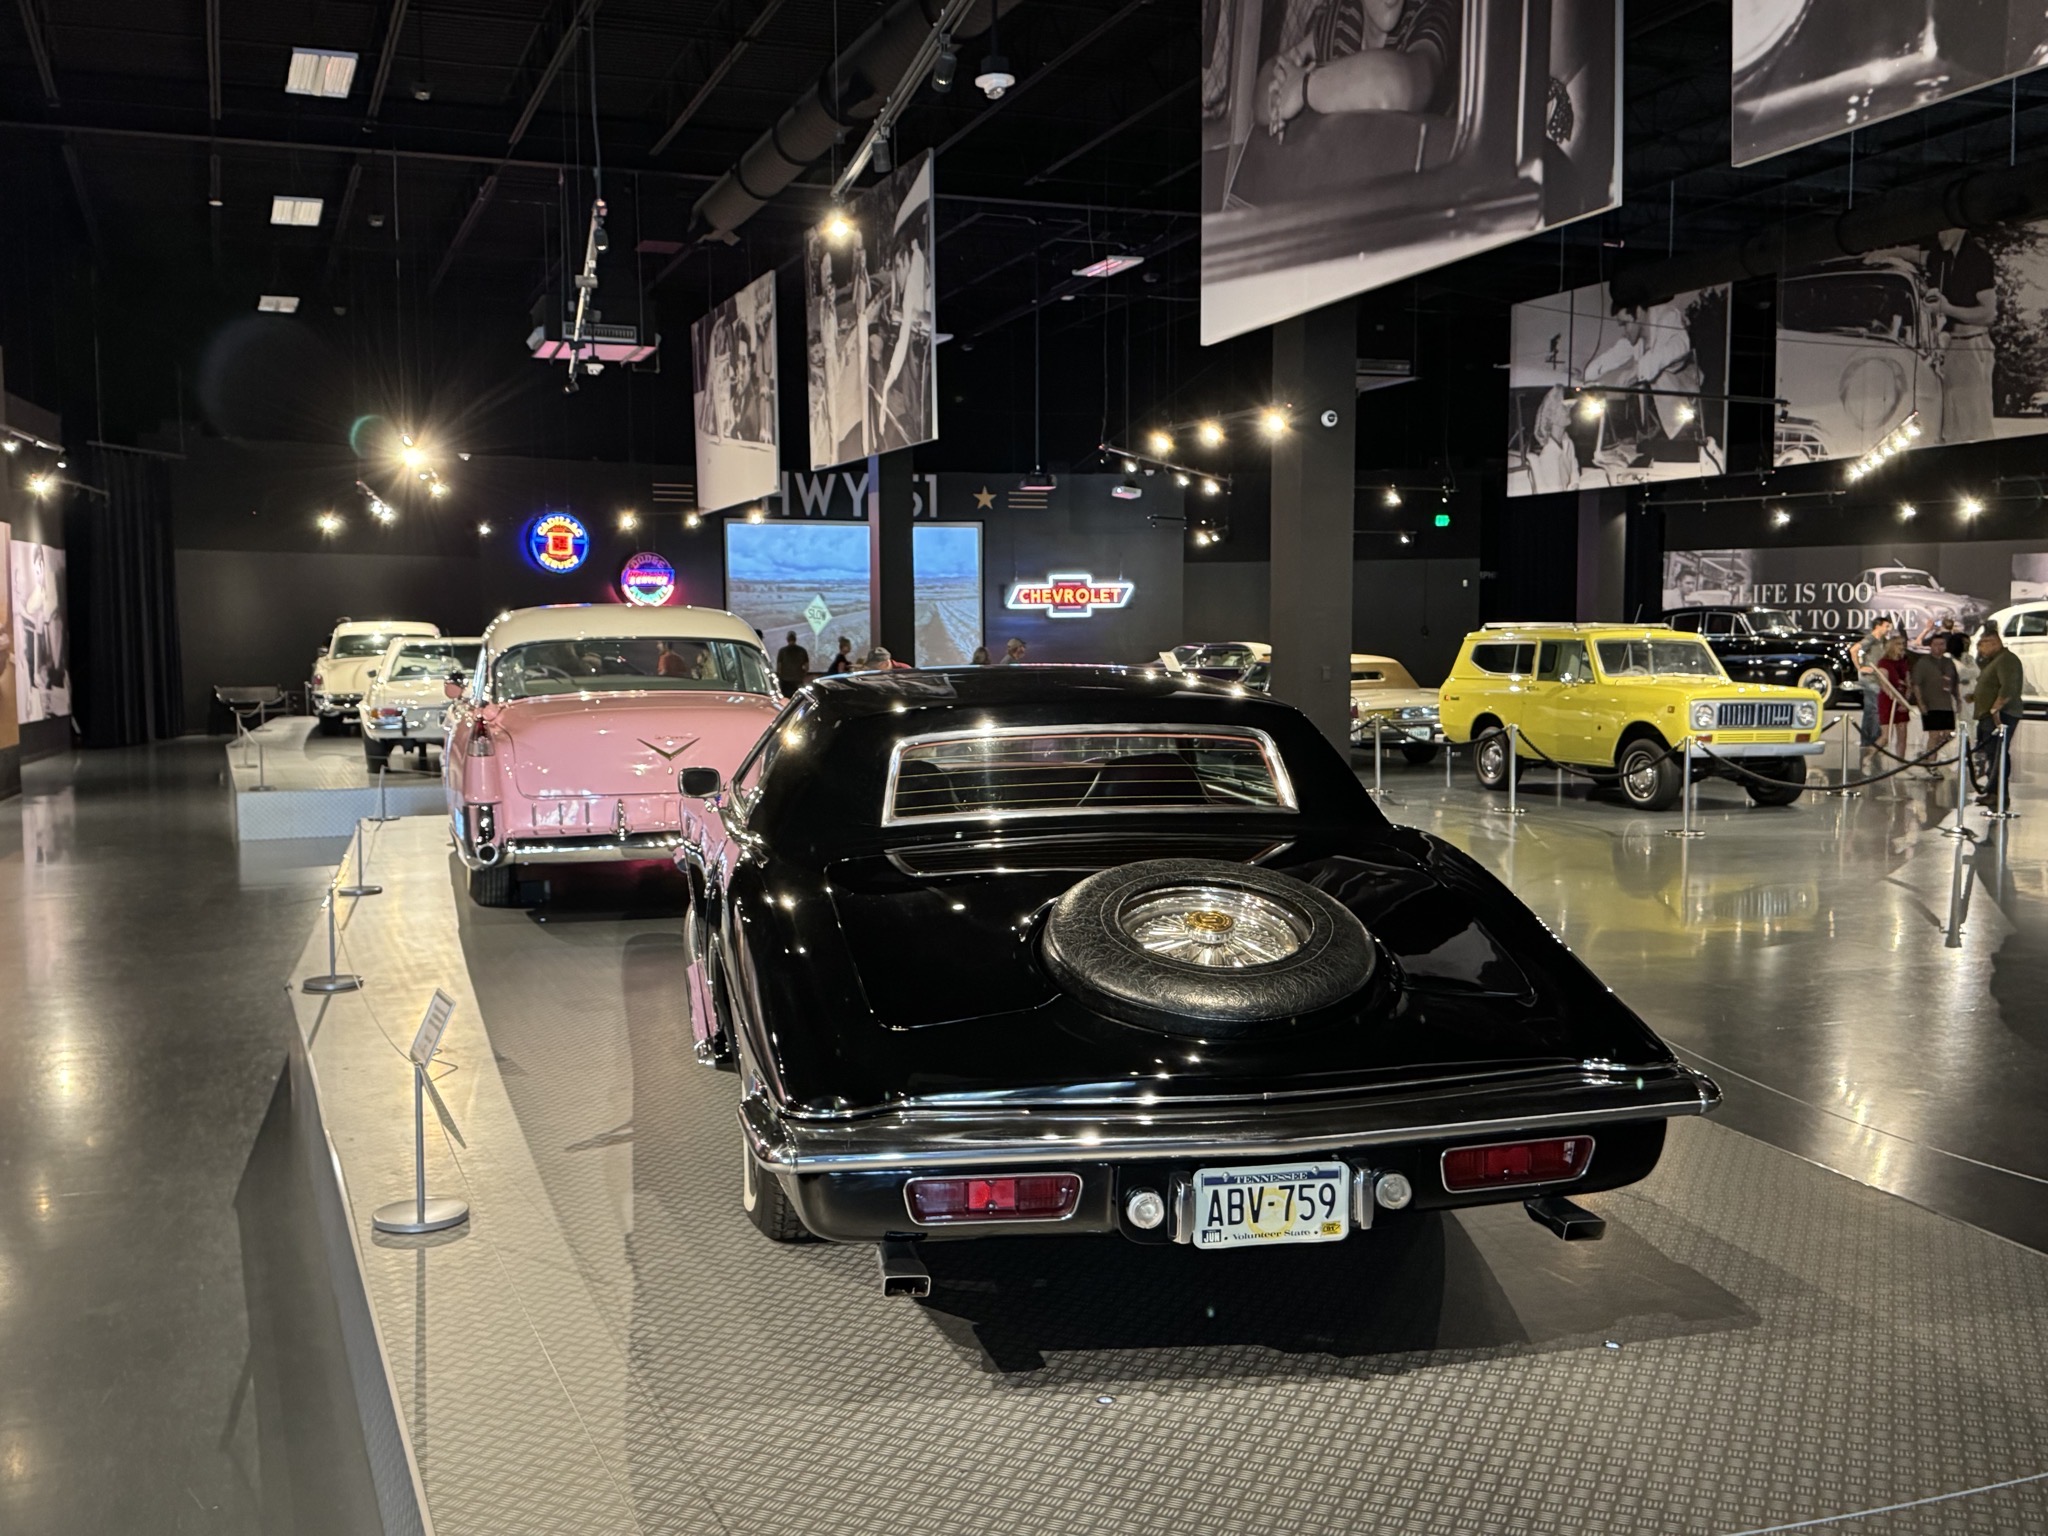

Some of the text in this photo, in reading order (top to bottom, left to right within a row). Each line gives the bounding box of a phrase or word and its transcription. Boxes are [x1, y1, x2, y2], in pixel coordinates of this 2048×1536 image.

[537, 515, 583, 538] CADILLAC
[540, 552, 579, 570] SERVICE
[630, 554, 666, 569] DODGE
[1018, 587, 1122, 604] CHEVROLET
[1738, 582, 1874, 604] LIFE IS TOO
[1807, 609, 1840, 630] TO
[1234, 1172, 1308, 1185] TENNESSEE
[1207, 1183, 1336, 1227] ABV-759
[1203, 1232, 1220, 1243] JUN
[1232, 1229, 1310, 1241] Volunteer State
